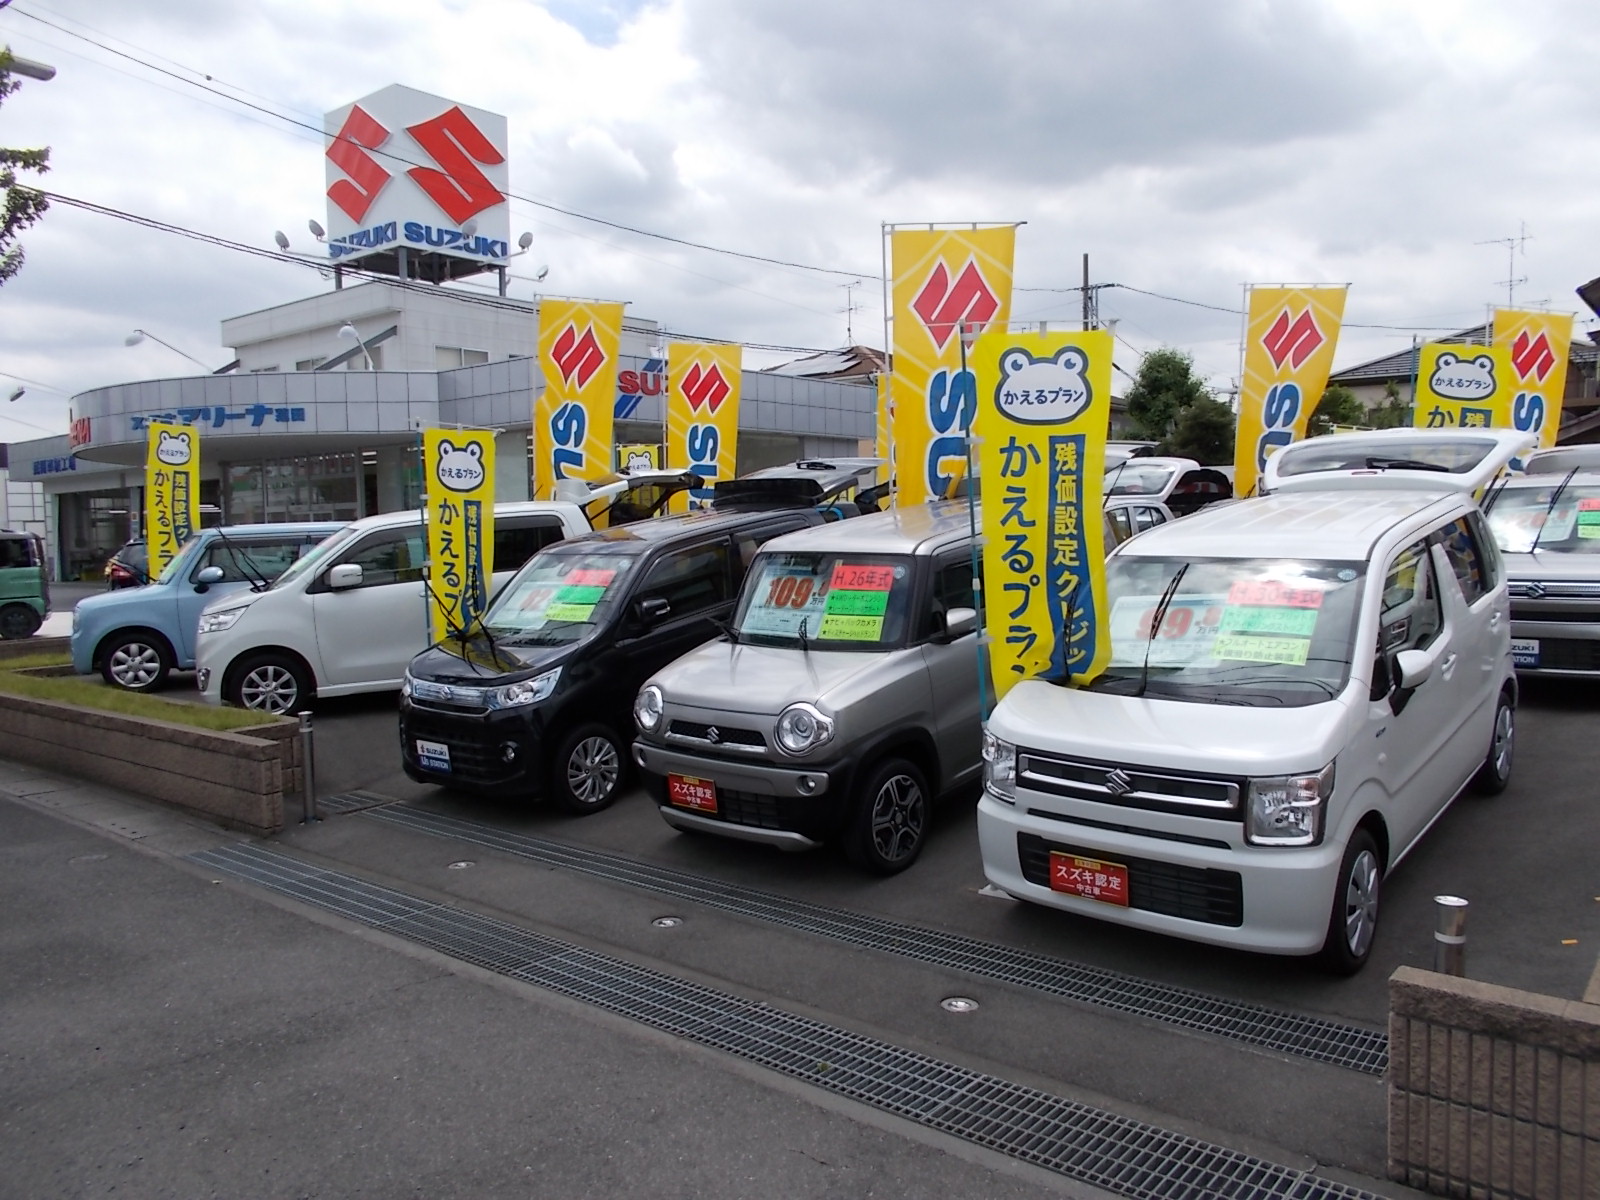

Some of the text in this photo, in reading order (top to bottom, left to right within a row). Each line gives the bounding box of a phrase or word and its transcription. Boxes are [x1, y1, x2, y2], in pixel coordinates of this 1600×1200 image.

[328, 221, 397, 259] SUZUKI
[404, 221, 508, 258] SUZUKI
[618, 370, 668, 396] SU
[1435, 377, 1491, 389] かえるプラン
[1003, 386, 1084, 406] かえるプラン
[441, 468, 481, 479] かえるプラン
[673, 782, 713, 800] スズキ認定
[1056, 865, 1121, 891] スズキ認定
[1076, 883, 1101, 896] 中古車
